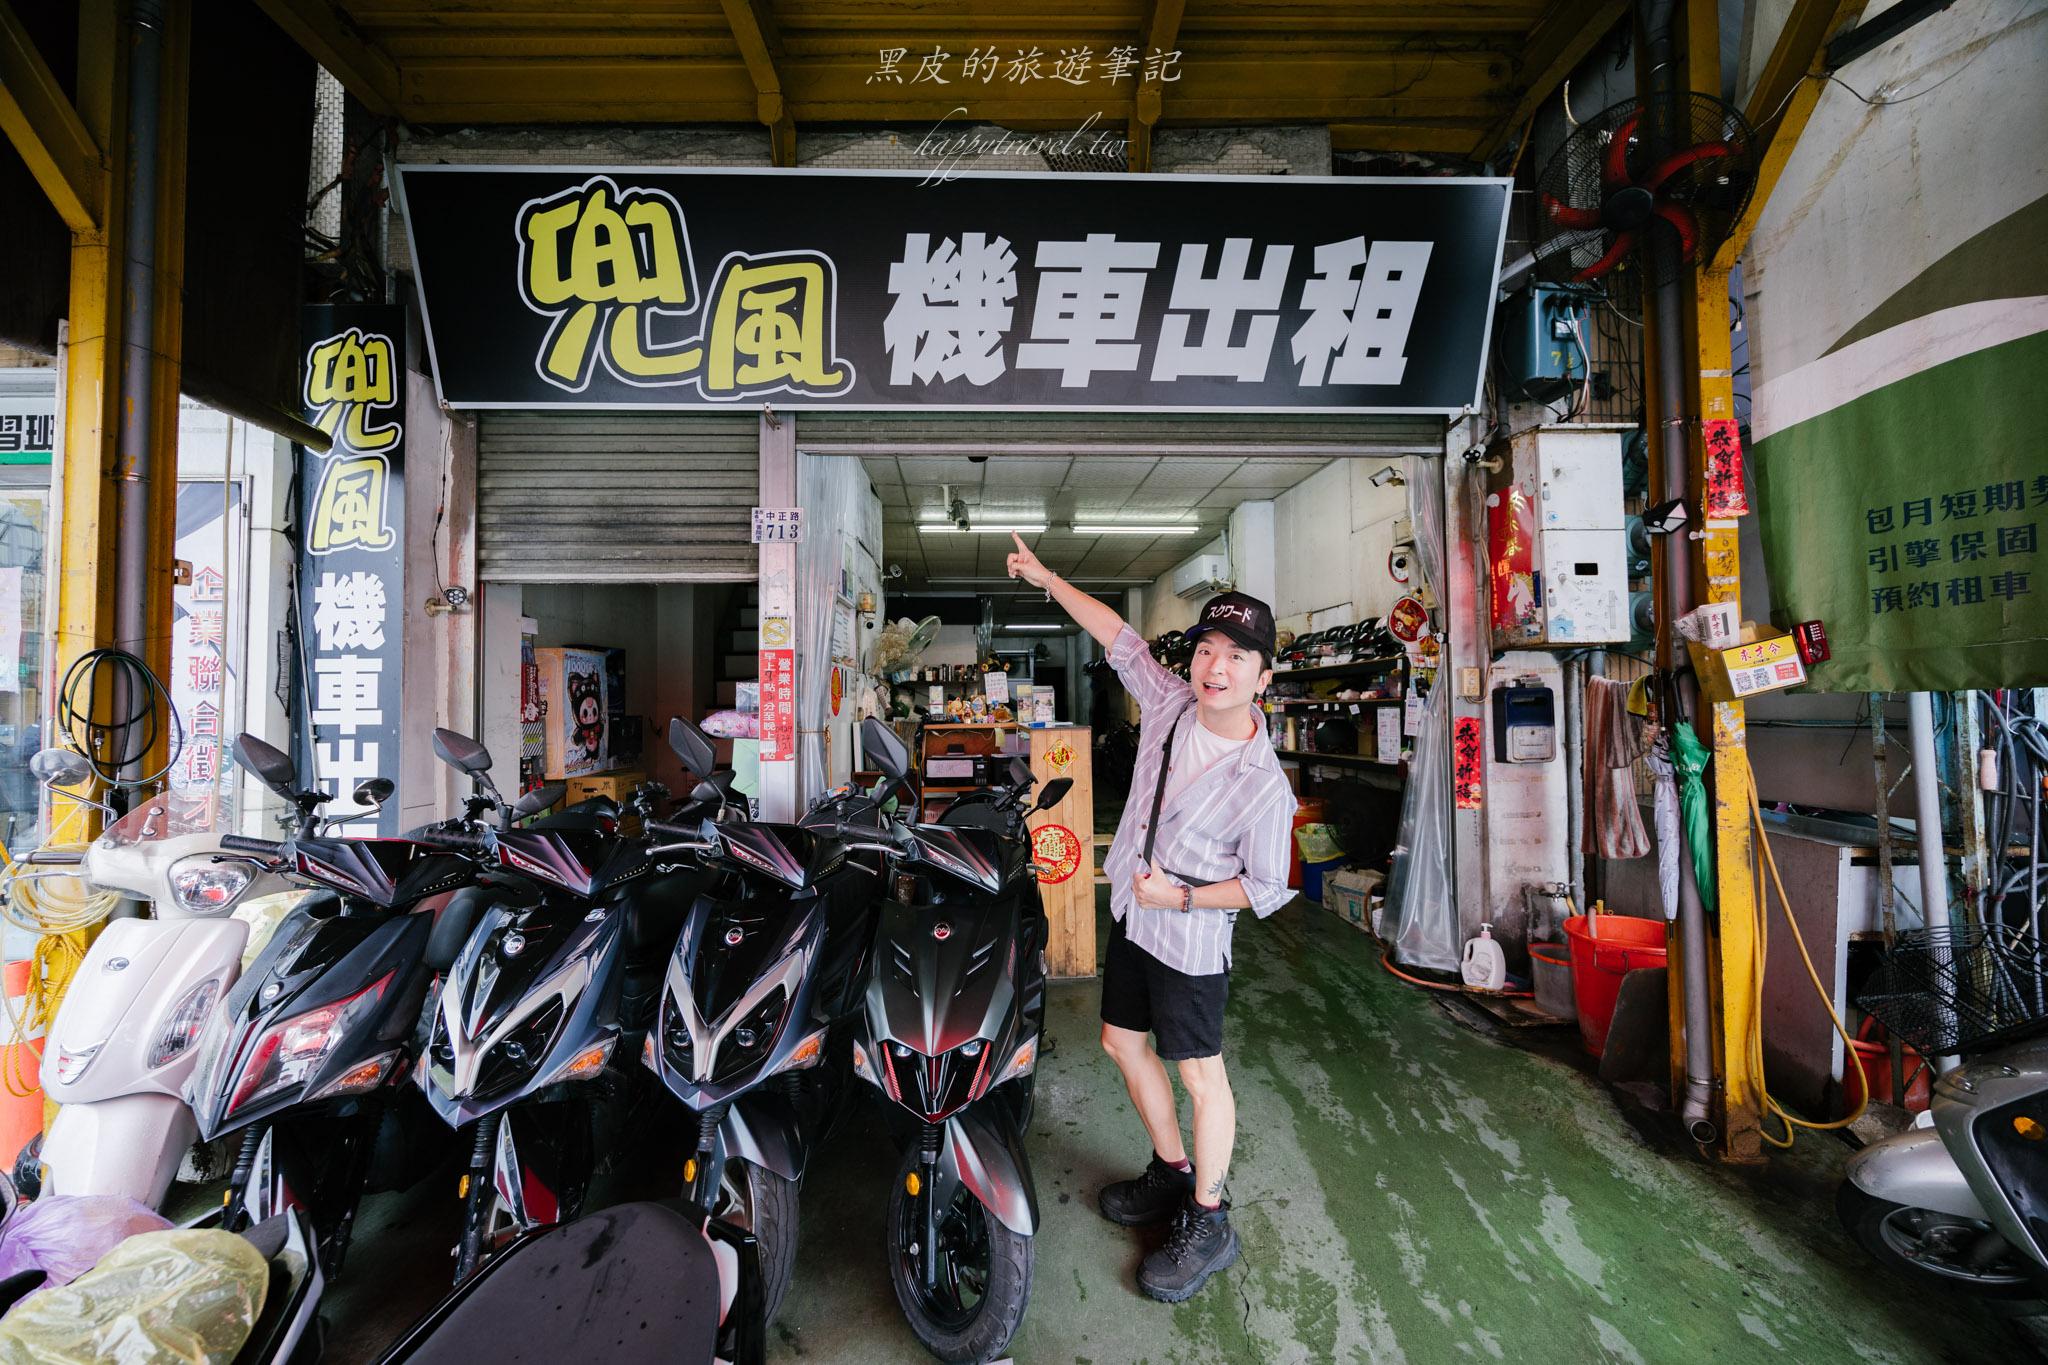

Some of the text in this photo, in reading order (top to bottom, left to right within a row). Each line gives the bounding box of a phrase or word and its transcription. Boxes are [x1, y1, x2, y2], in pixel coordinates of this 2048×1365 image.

[515, 175, 1435, 400] 兜風 機車出租
[766, 511, 799, 521] 中正路
[767, 523, 798, 540] 713
[1867, 522, 2038, 574] 引擎保固
[304, 327, 401, 838] 兜風 機車出
[1871, 570, 2031, 615] 預約租車
